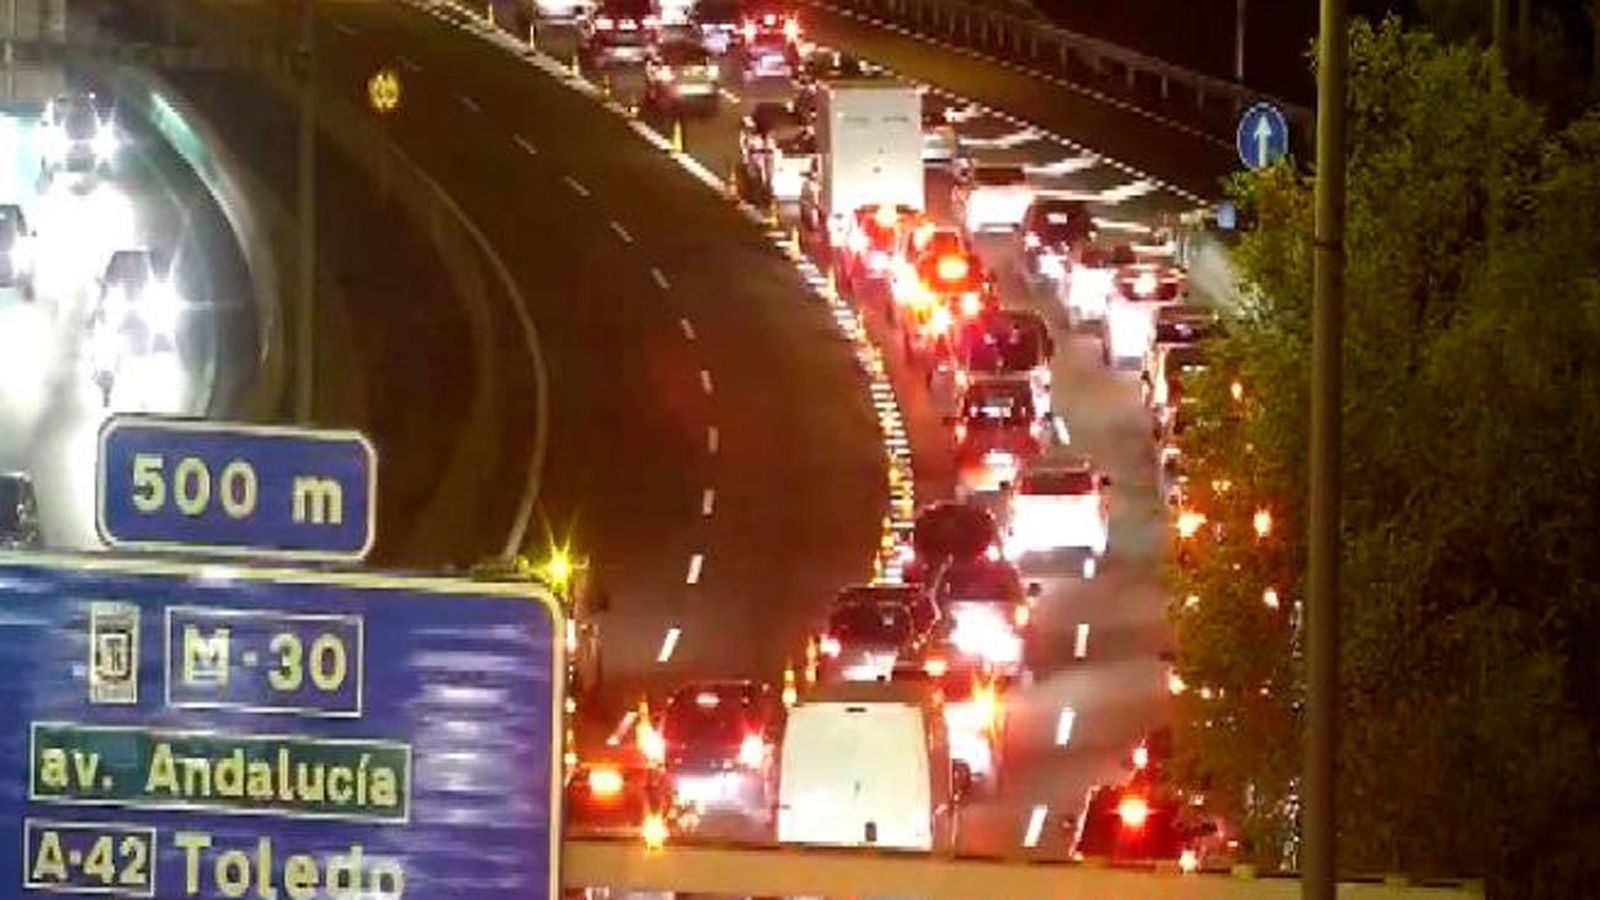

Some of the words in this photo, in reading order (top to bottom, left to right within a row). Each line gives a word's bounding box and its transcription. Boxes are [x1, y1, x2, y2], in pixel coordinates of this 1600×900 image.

[132, 453, 258, 519] 500
[292, 476, 343, 525] m
[184, 624, 348, 692] M-30
[40, 747, 114, 790] av.
[144, 743, 398, 806] Andalucía
[32, 831, 148, 884] A-42
[174, 831, 405, 900] Toledo
